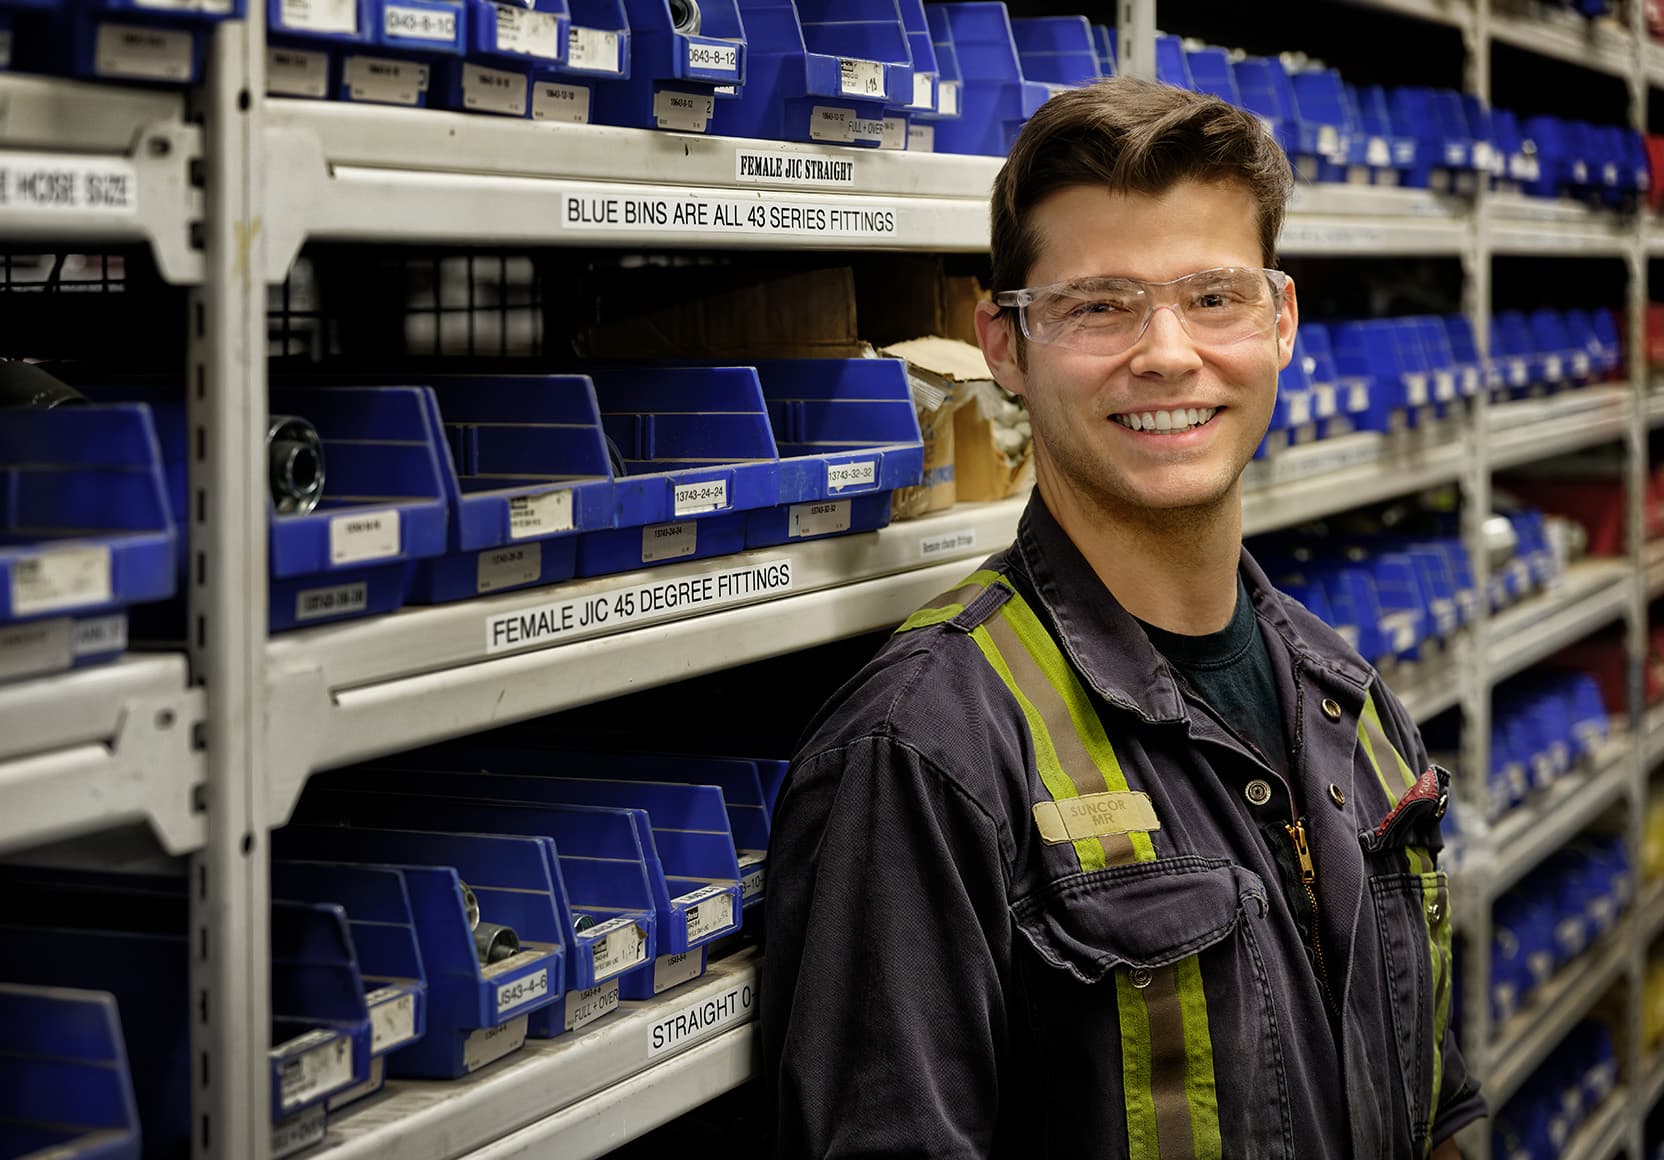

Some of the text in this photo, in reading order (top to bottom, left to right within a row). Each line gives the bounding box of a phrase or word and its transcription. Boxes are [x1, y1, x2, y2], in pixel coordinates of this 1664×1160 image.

[706, 100, 712, 114] 2
[740, 155, 853, 181] FEMALE JIC STRAIGHT
[568, 198, 894, 232] BLUE BINS ARE ALL 43 SERIES FITTINGS
[828, 467, 872, 481] 13743-32-32
[676, 486, 723, 502] 13743-24-24
[493, 563, 790, 647] FEMALE JIC 45 DEGREE FITTINGS
[1070, 799, 1127, 817] SUNCOR
[1092, 814, 1114, 826] MR
[574, 1003, 592, 1023] FULL
[599, 987, 618, 1009] OVER
[652, 990, 738, 1049] STRAIGHT
